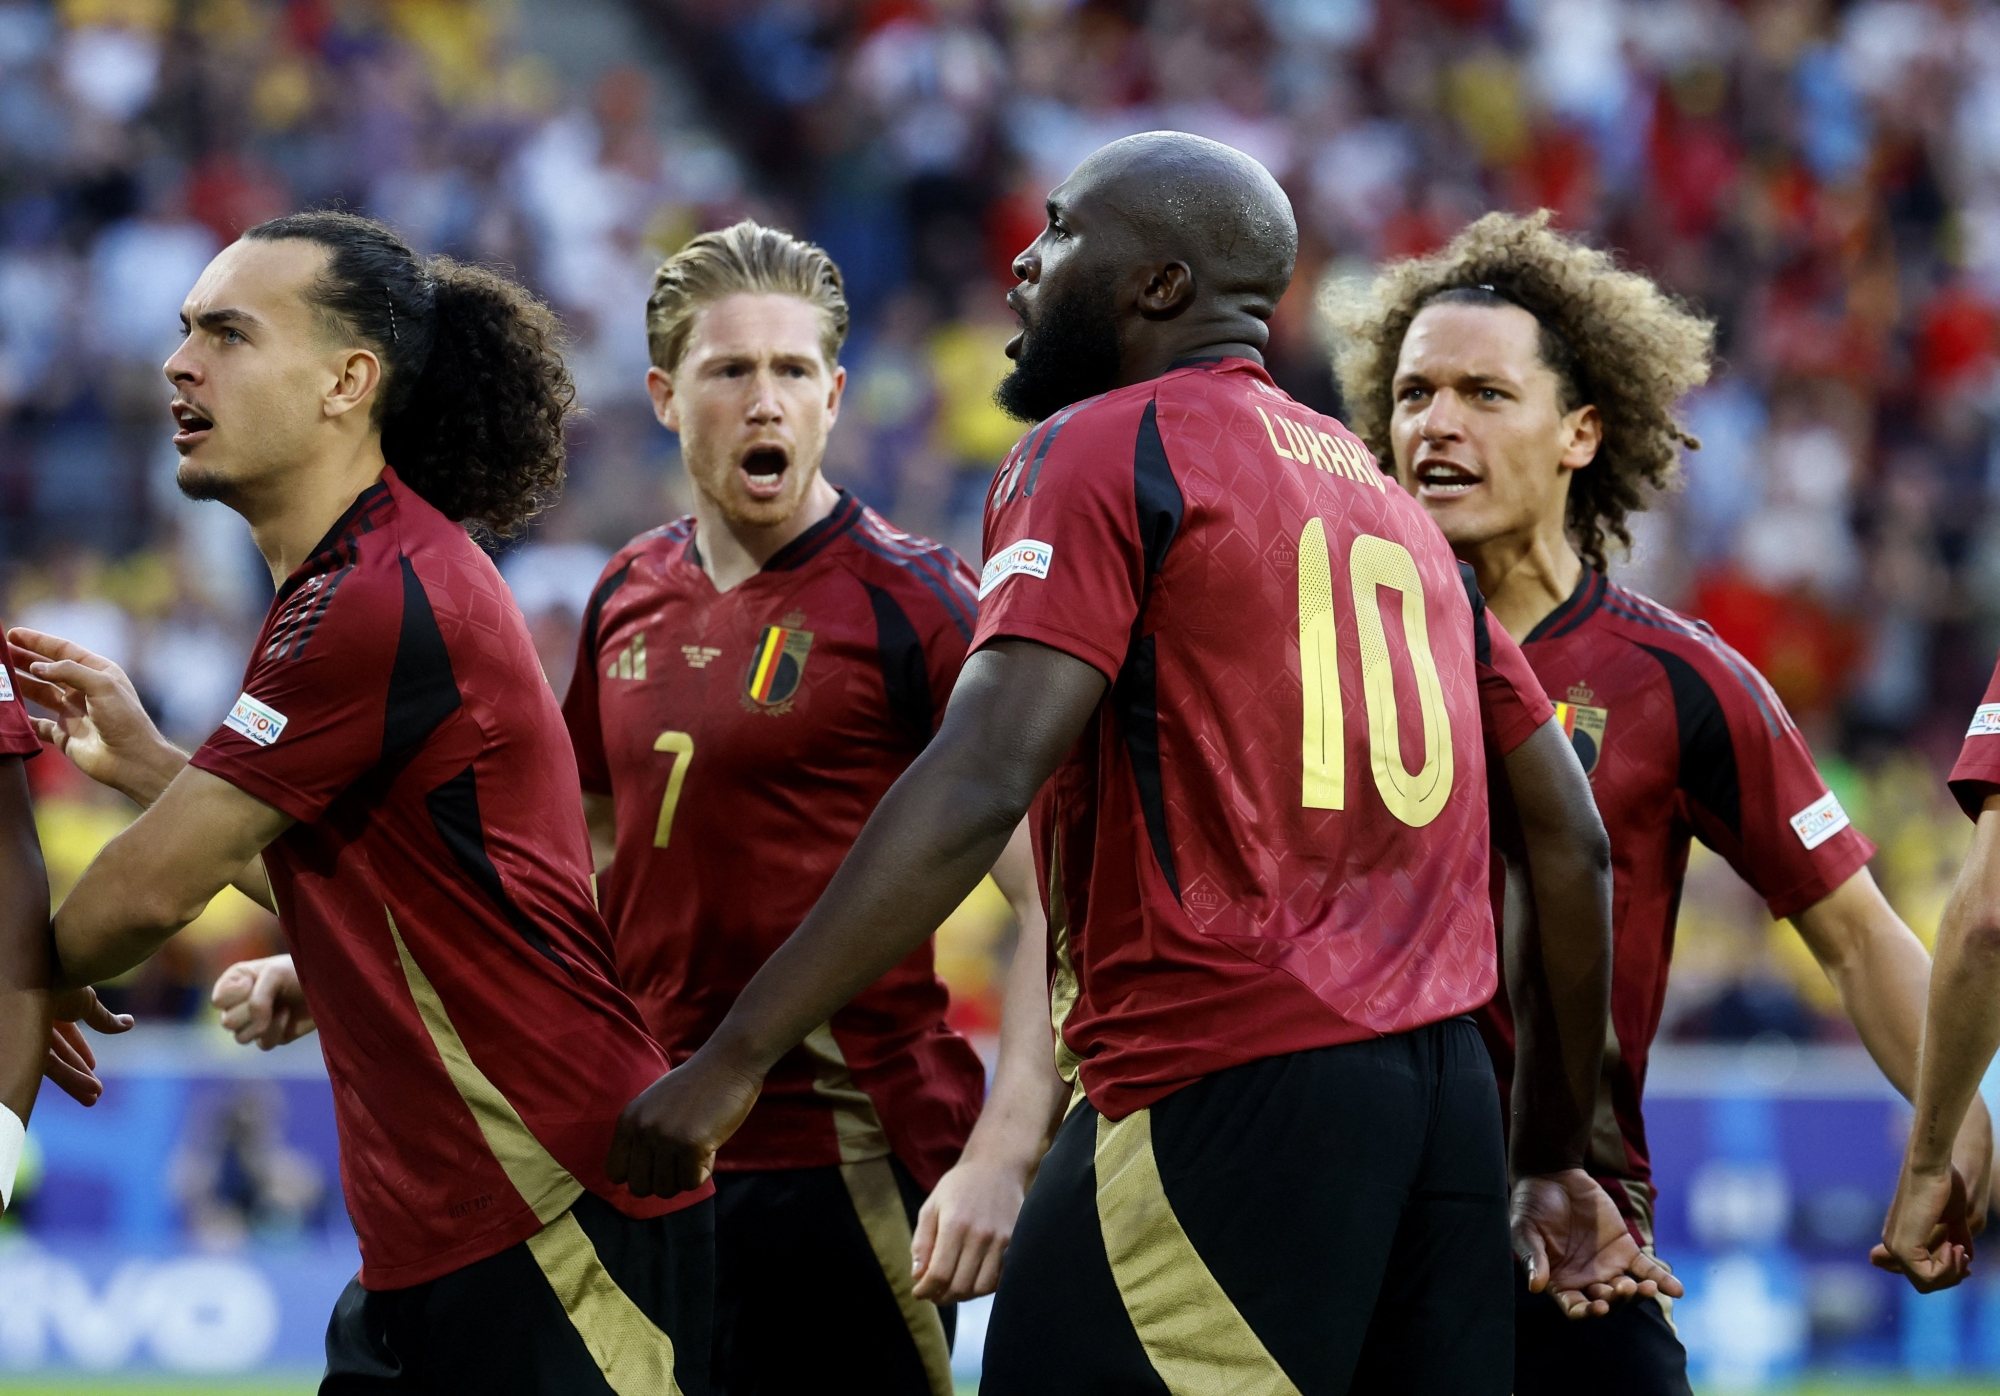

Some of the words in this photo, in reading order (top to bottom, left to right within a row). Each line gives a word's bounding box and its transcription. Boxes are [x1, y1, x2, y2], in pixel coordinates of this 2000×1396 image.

[1255, 405, 1386, 495] LUKAKU
[1298, 516, 1455, 828] 10
[653, 730, 695, 848] 7
